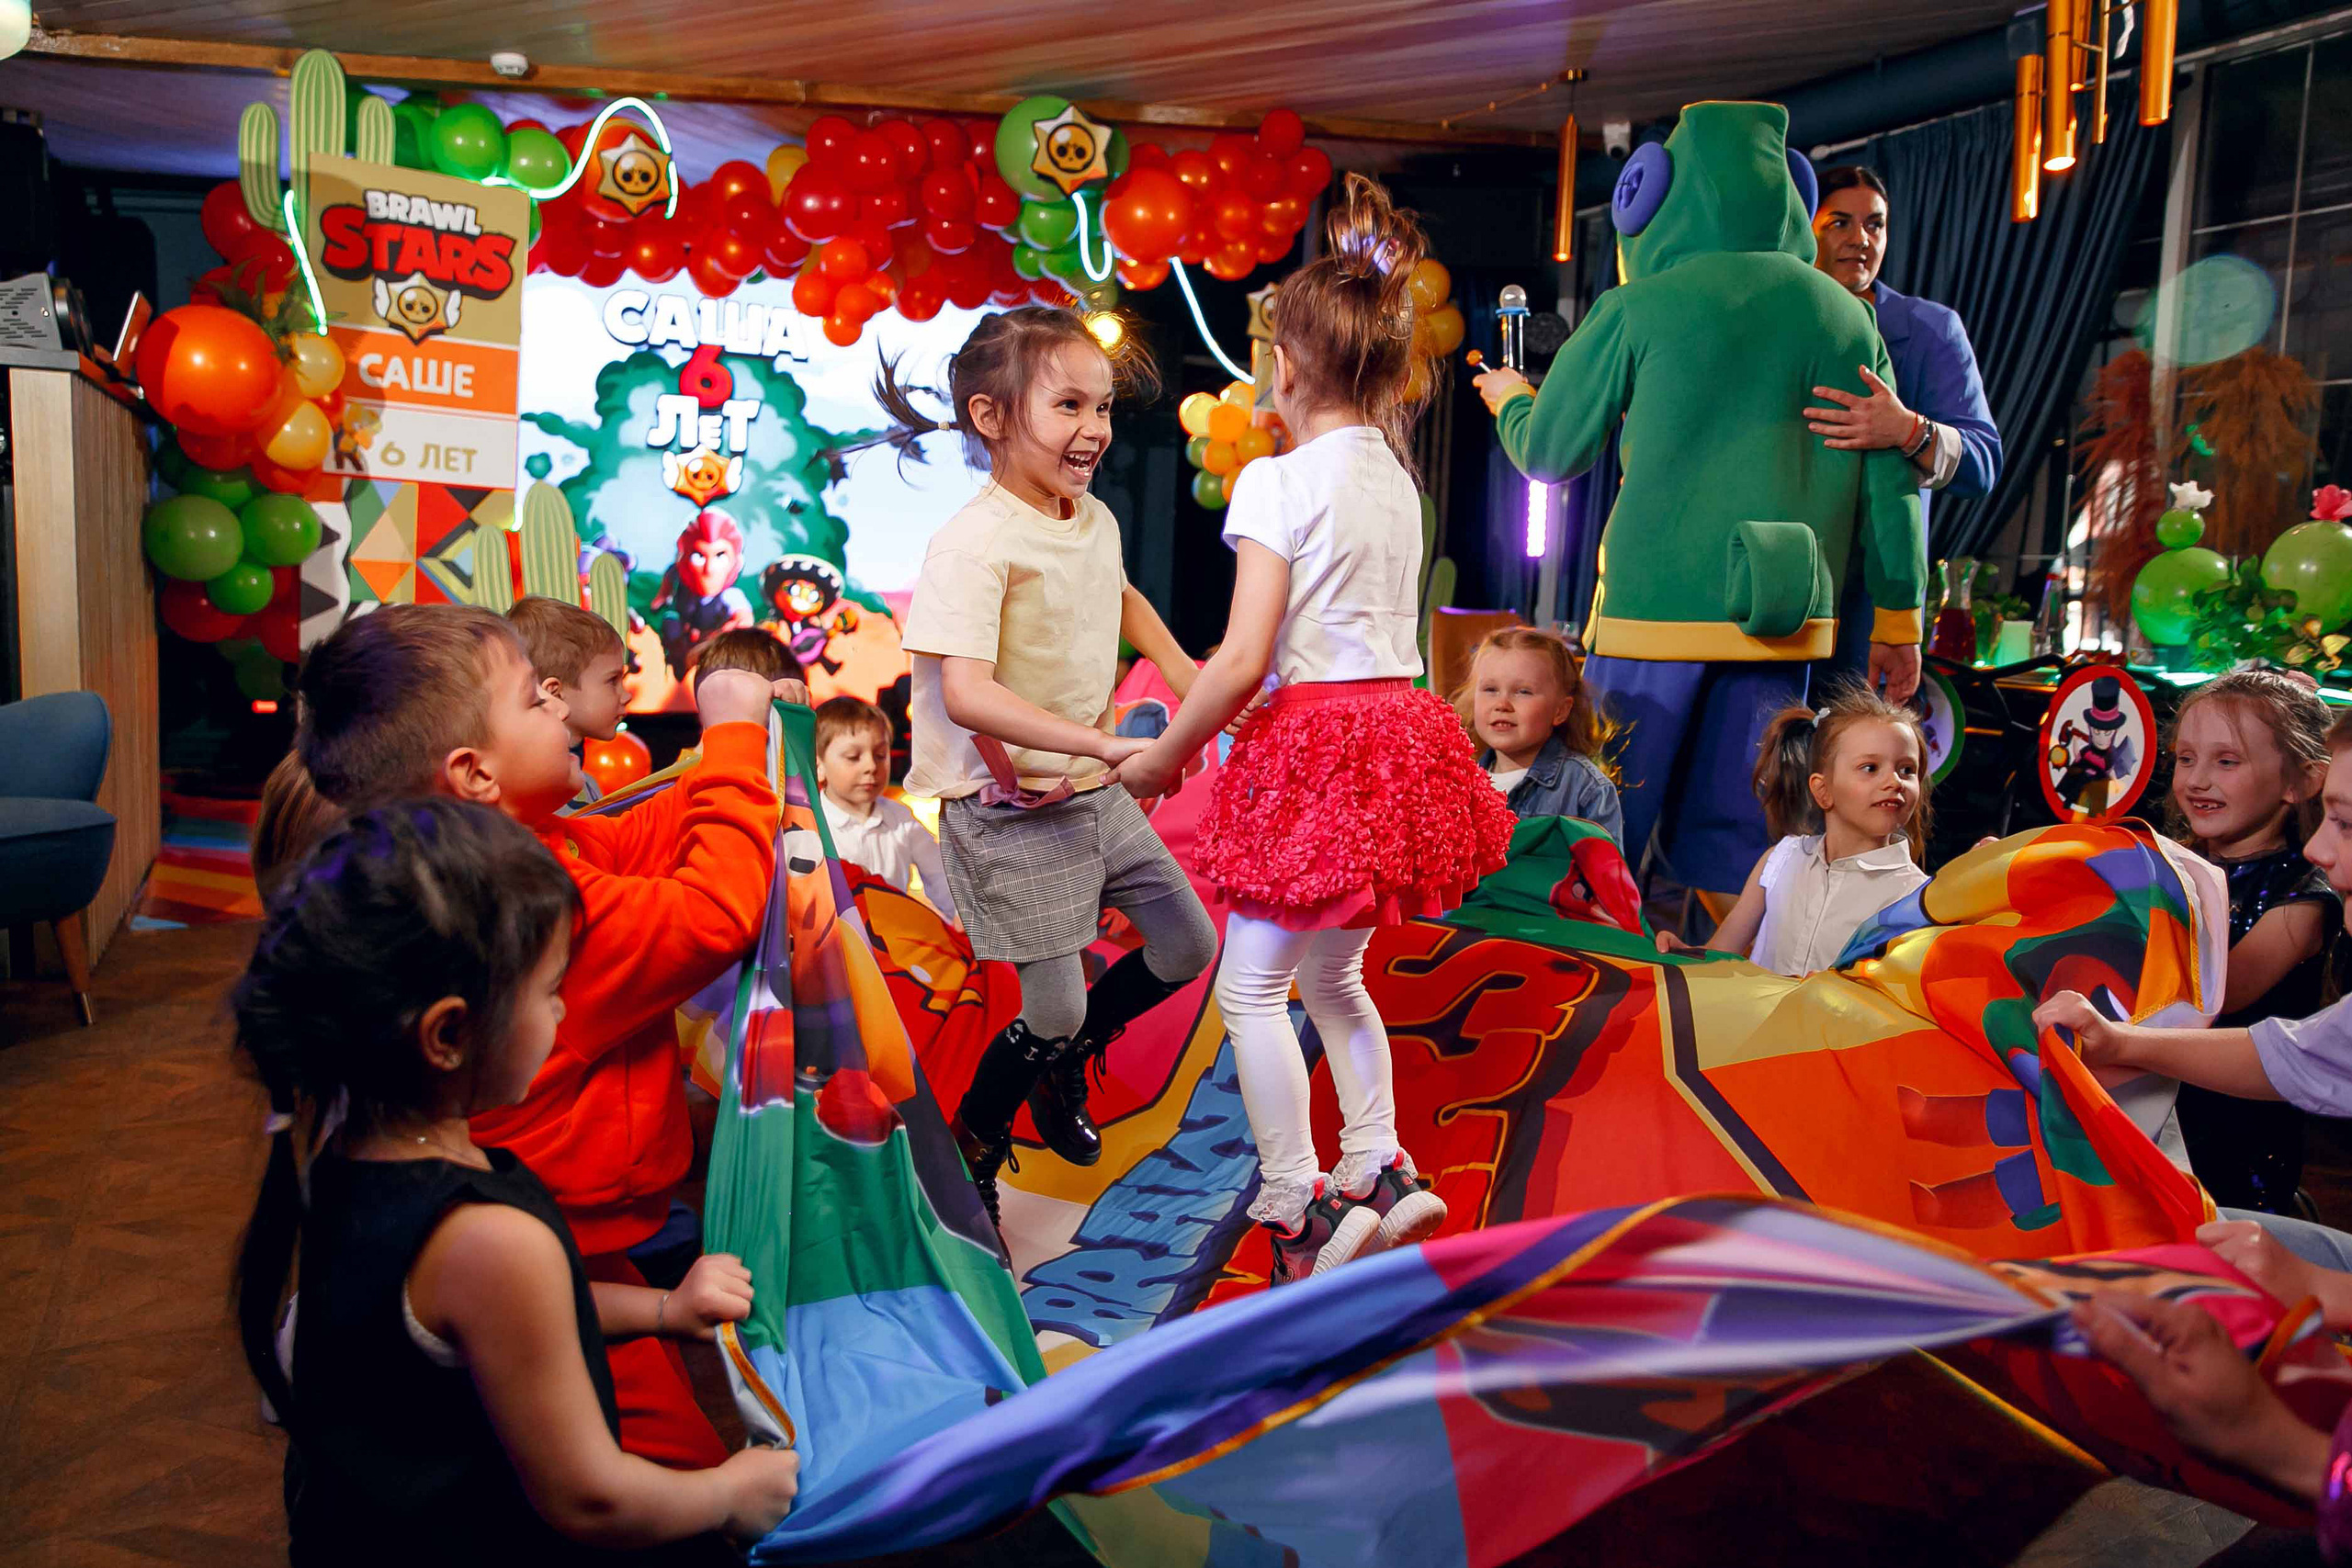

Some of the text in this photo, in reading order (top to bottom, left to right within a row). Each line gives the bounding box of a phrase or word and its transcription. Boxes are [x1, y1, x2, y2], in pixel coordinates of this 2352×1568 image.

[365, 190, 483, 235] BRAWL
[321, 204, 516, 300] STARS
[603, 288, 808, 361] САША
[358, 353, 475, 398] САШЕ
[679, 344, 733, 408] 6
[380, 441, 478, 473] 6 ЛЕТ
